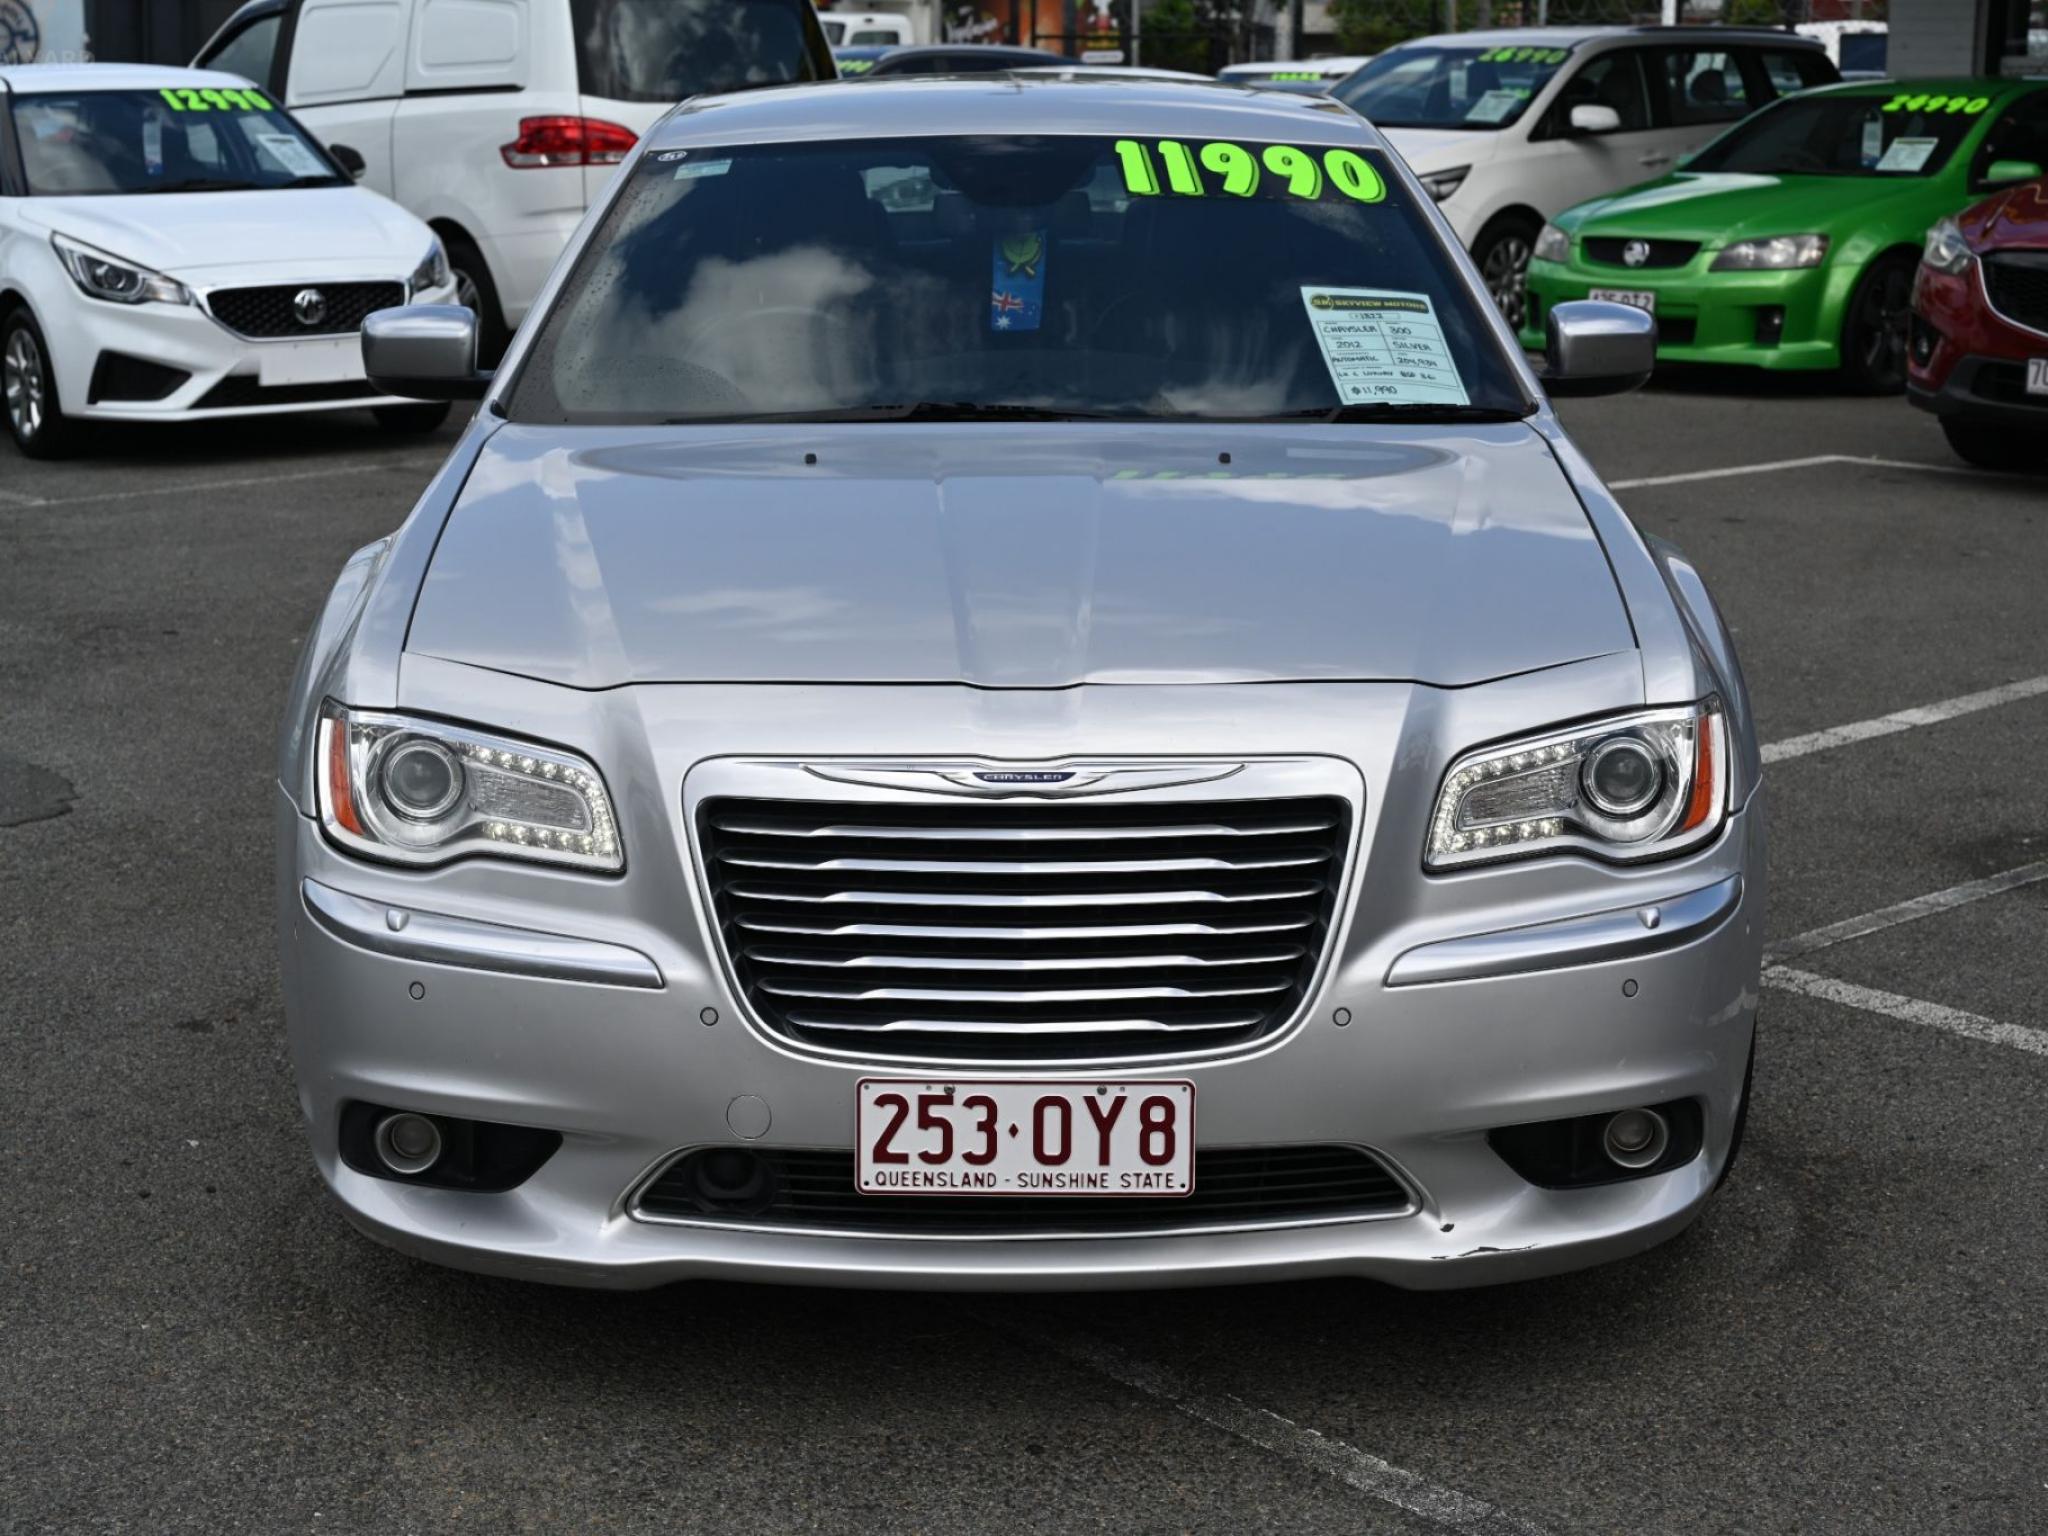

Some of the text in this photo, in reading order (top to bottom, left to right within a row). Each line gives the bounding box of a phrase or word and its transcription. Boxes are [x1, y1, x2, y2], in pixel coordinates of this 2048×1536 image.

[160, 88, 273, 112] 12990
[1115, 140, 1387, 203] 11990
[1334, 299, 1427, 310] SKYVIEW MOTORS
[1323, 325, 1378, 334] CHRYSLER
[1389, 326, 1412, 335] 300
[1336, 341, 1363, 349] 2012
[1392, 341, 1432, 352] SILVER
[1351, 385, 1398, 396] $11,990
[874, 1170, 997, 1187] QUEENSLAND
[1017, 1172, 1109, 1188] SUNSHINE
[1120, 1173, 1175, 1188] STATE
